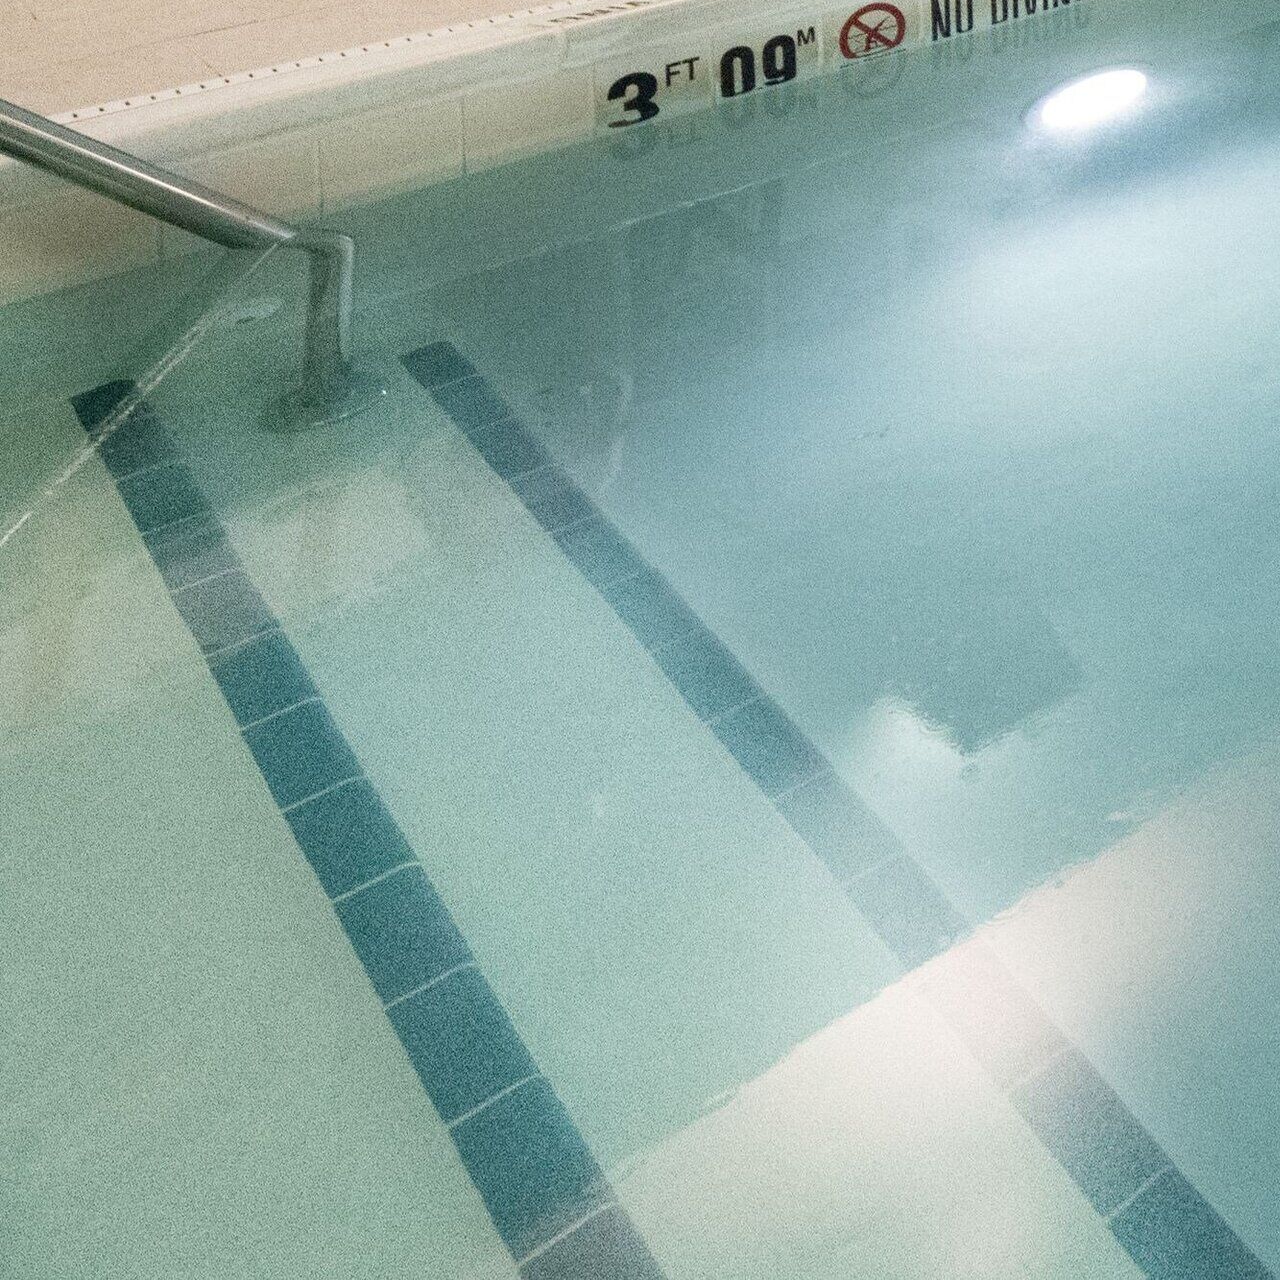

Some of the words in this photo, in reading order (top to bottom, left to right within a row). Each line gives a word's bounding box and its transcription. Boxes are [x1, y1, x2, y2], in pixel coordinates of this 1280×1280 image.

[607, 72, 660, 128] 3
[665, 56, 700, 88] FT
[797, 26, 816, 47] M
